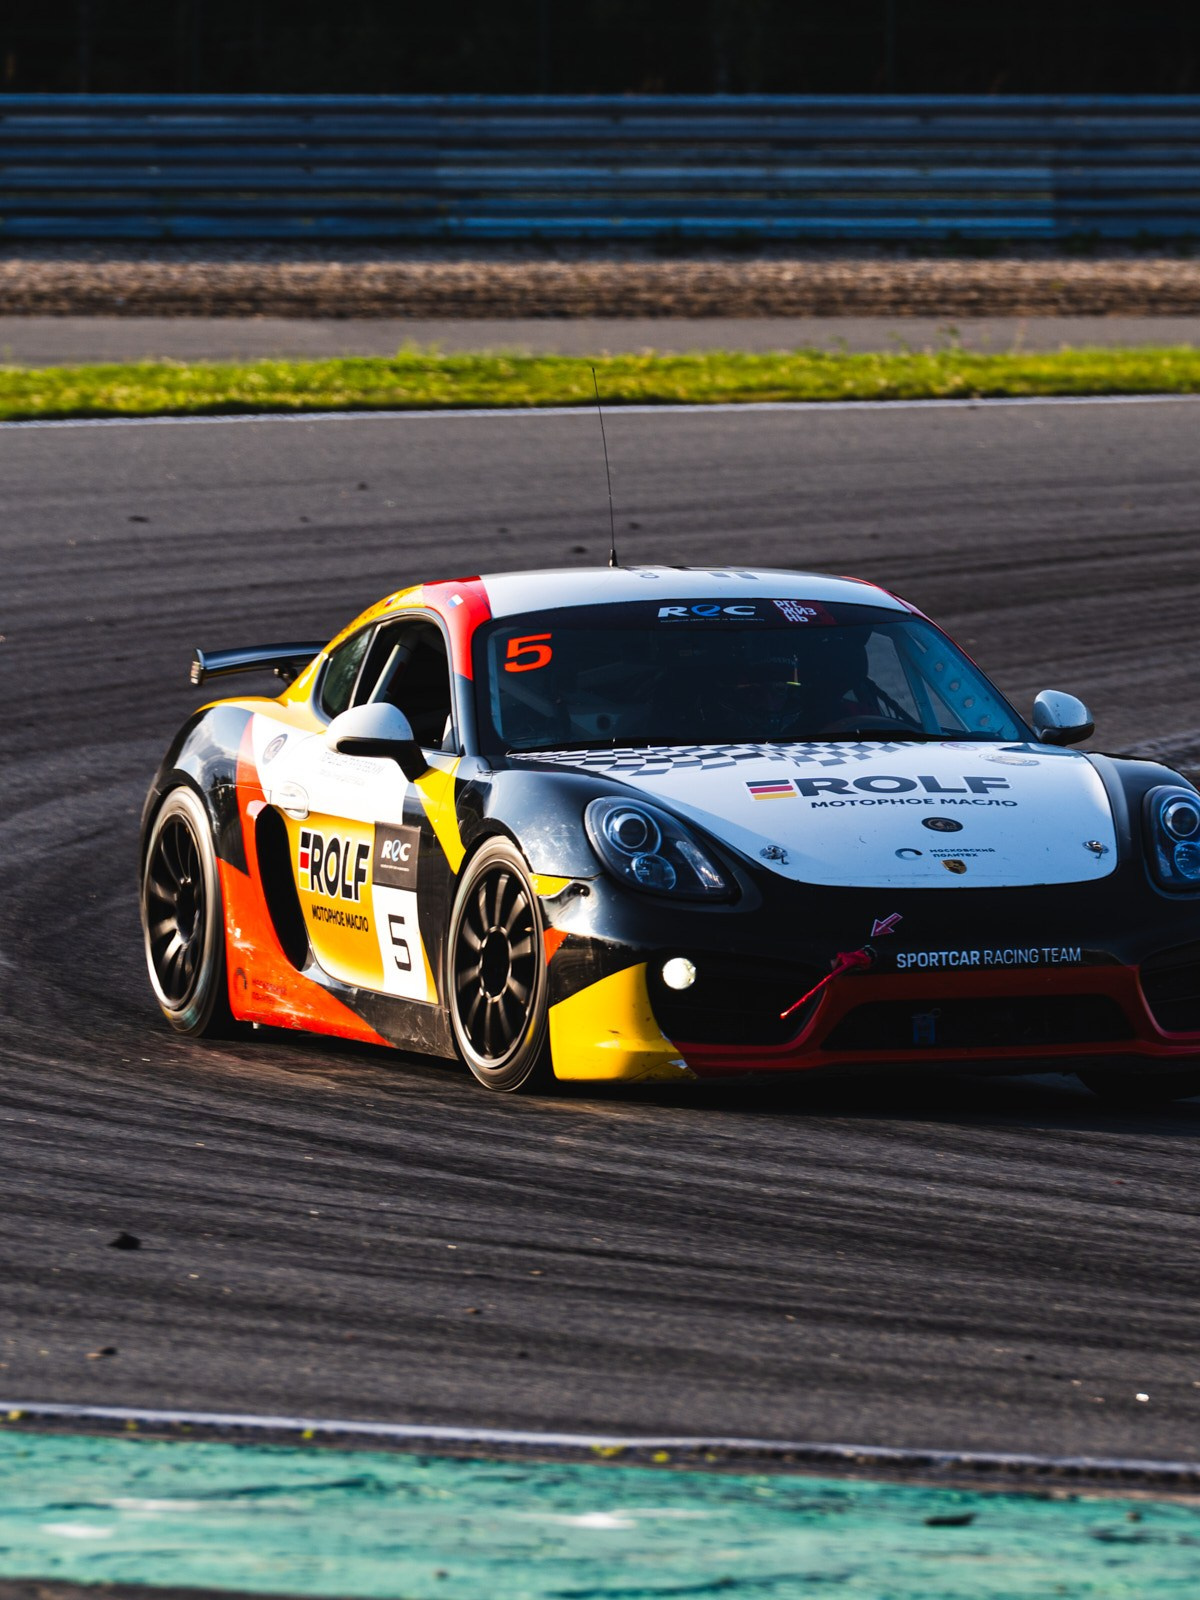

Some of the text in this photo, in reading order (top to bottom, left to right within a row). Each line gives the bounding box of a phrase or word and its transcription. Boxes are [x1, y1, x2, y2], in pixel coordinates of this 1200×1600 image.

[504, 633, 553, 673] 5
[794, 775, 1010, 797] ROLF
[811, 798, 1018, 808] МОТОРНОЕ МАСЛО
[310, 833, 370, 901] ROLF
[311, 904, 369, 932] МОТОРНОЕ МАСЛО
[388, 913, 411, 972] 5
[896, 947, 1081, 968] SPORTCAR RACING TEAM
